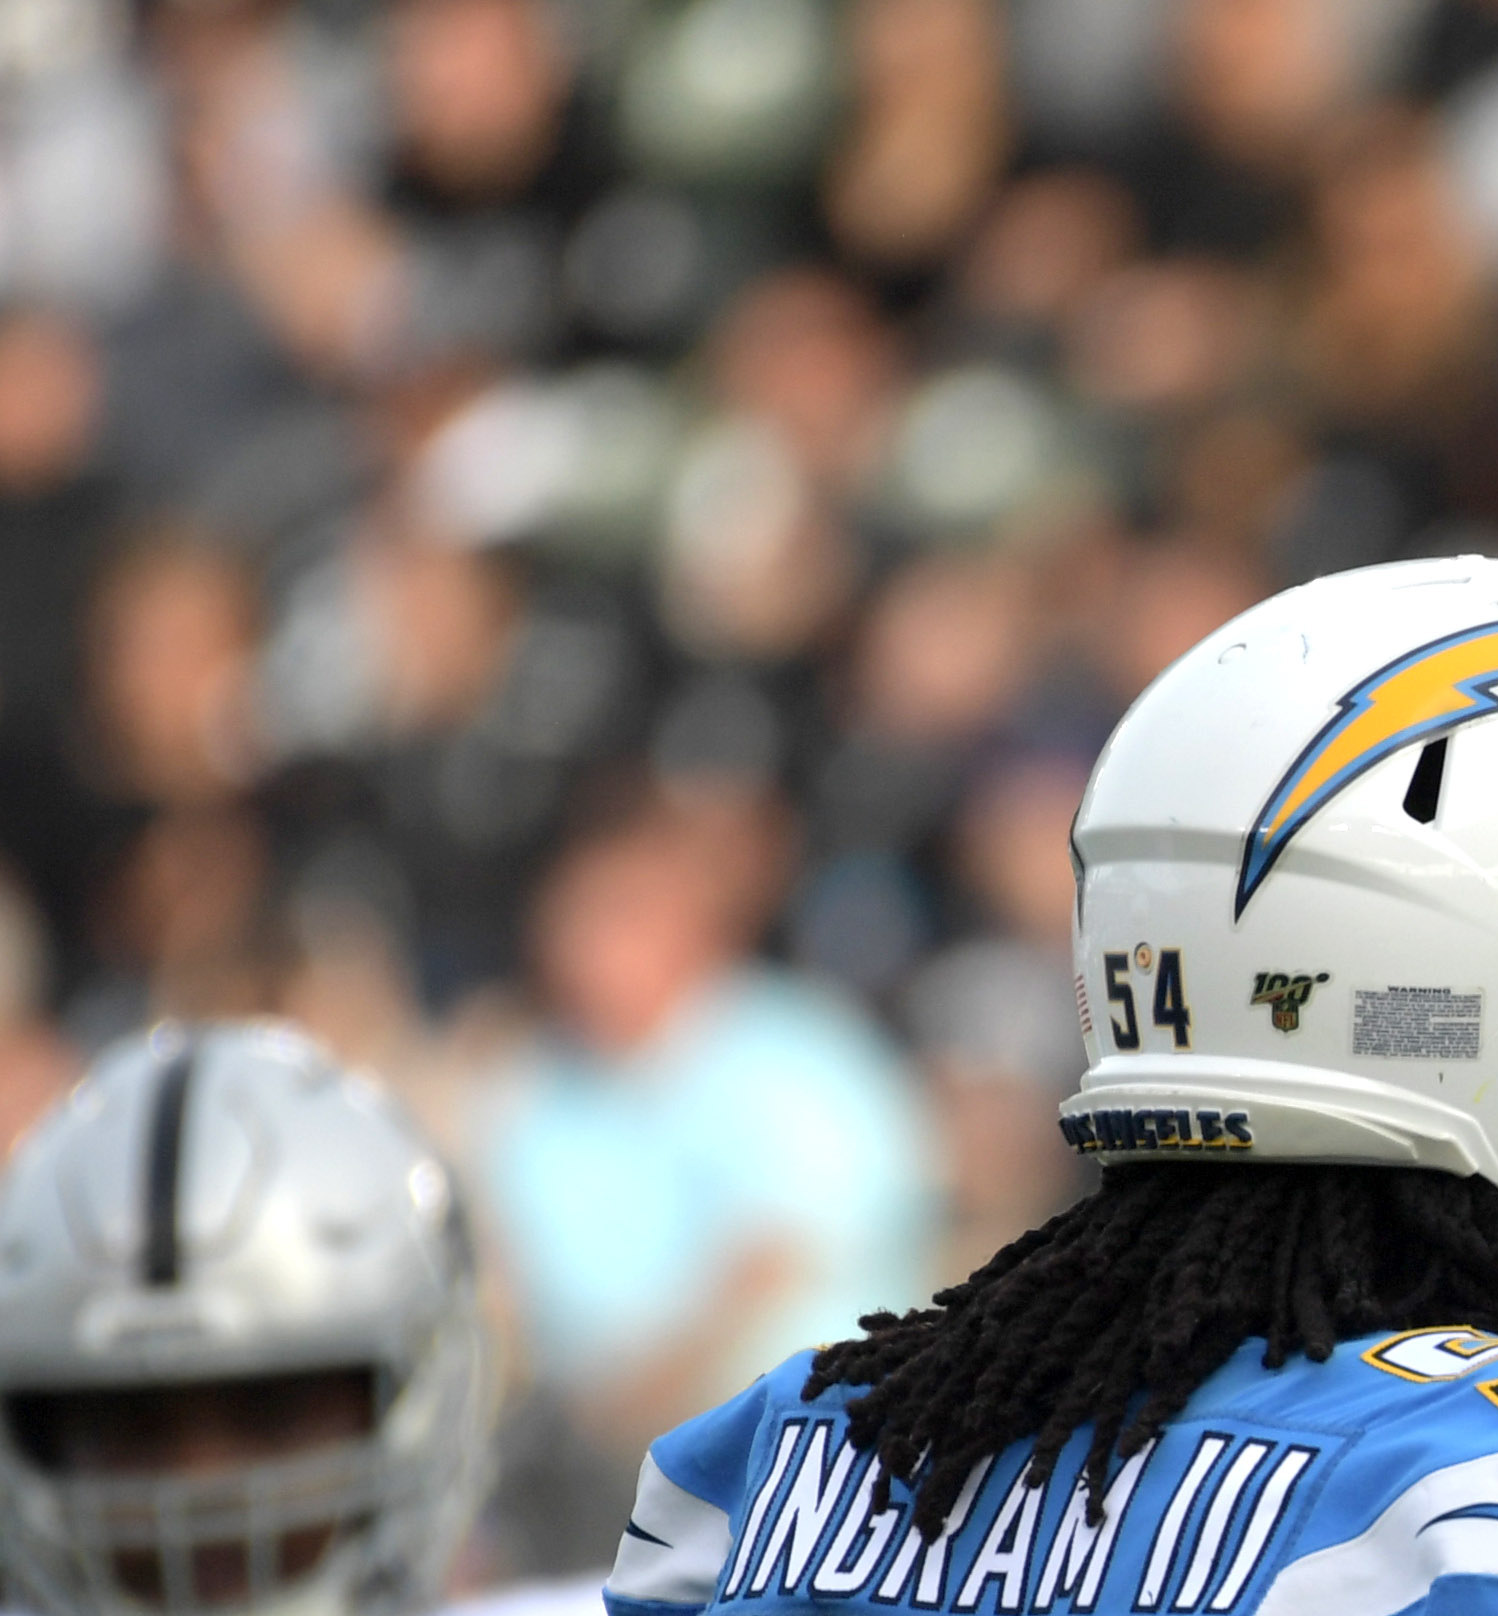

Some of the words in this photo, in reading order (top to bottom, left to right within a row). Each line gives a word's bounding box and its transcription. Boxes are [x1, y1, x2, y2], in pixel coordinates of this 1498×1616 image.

[1103, 948, 1191, 1051] 54
[1387, 985, 1452, 995] WARNING
[1130, 1410, 1321, 1615] III
